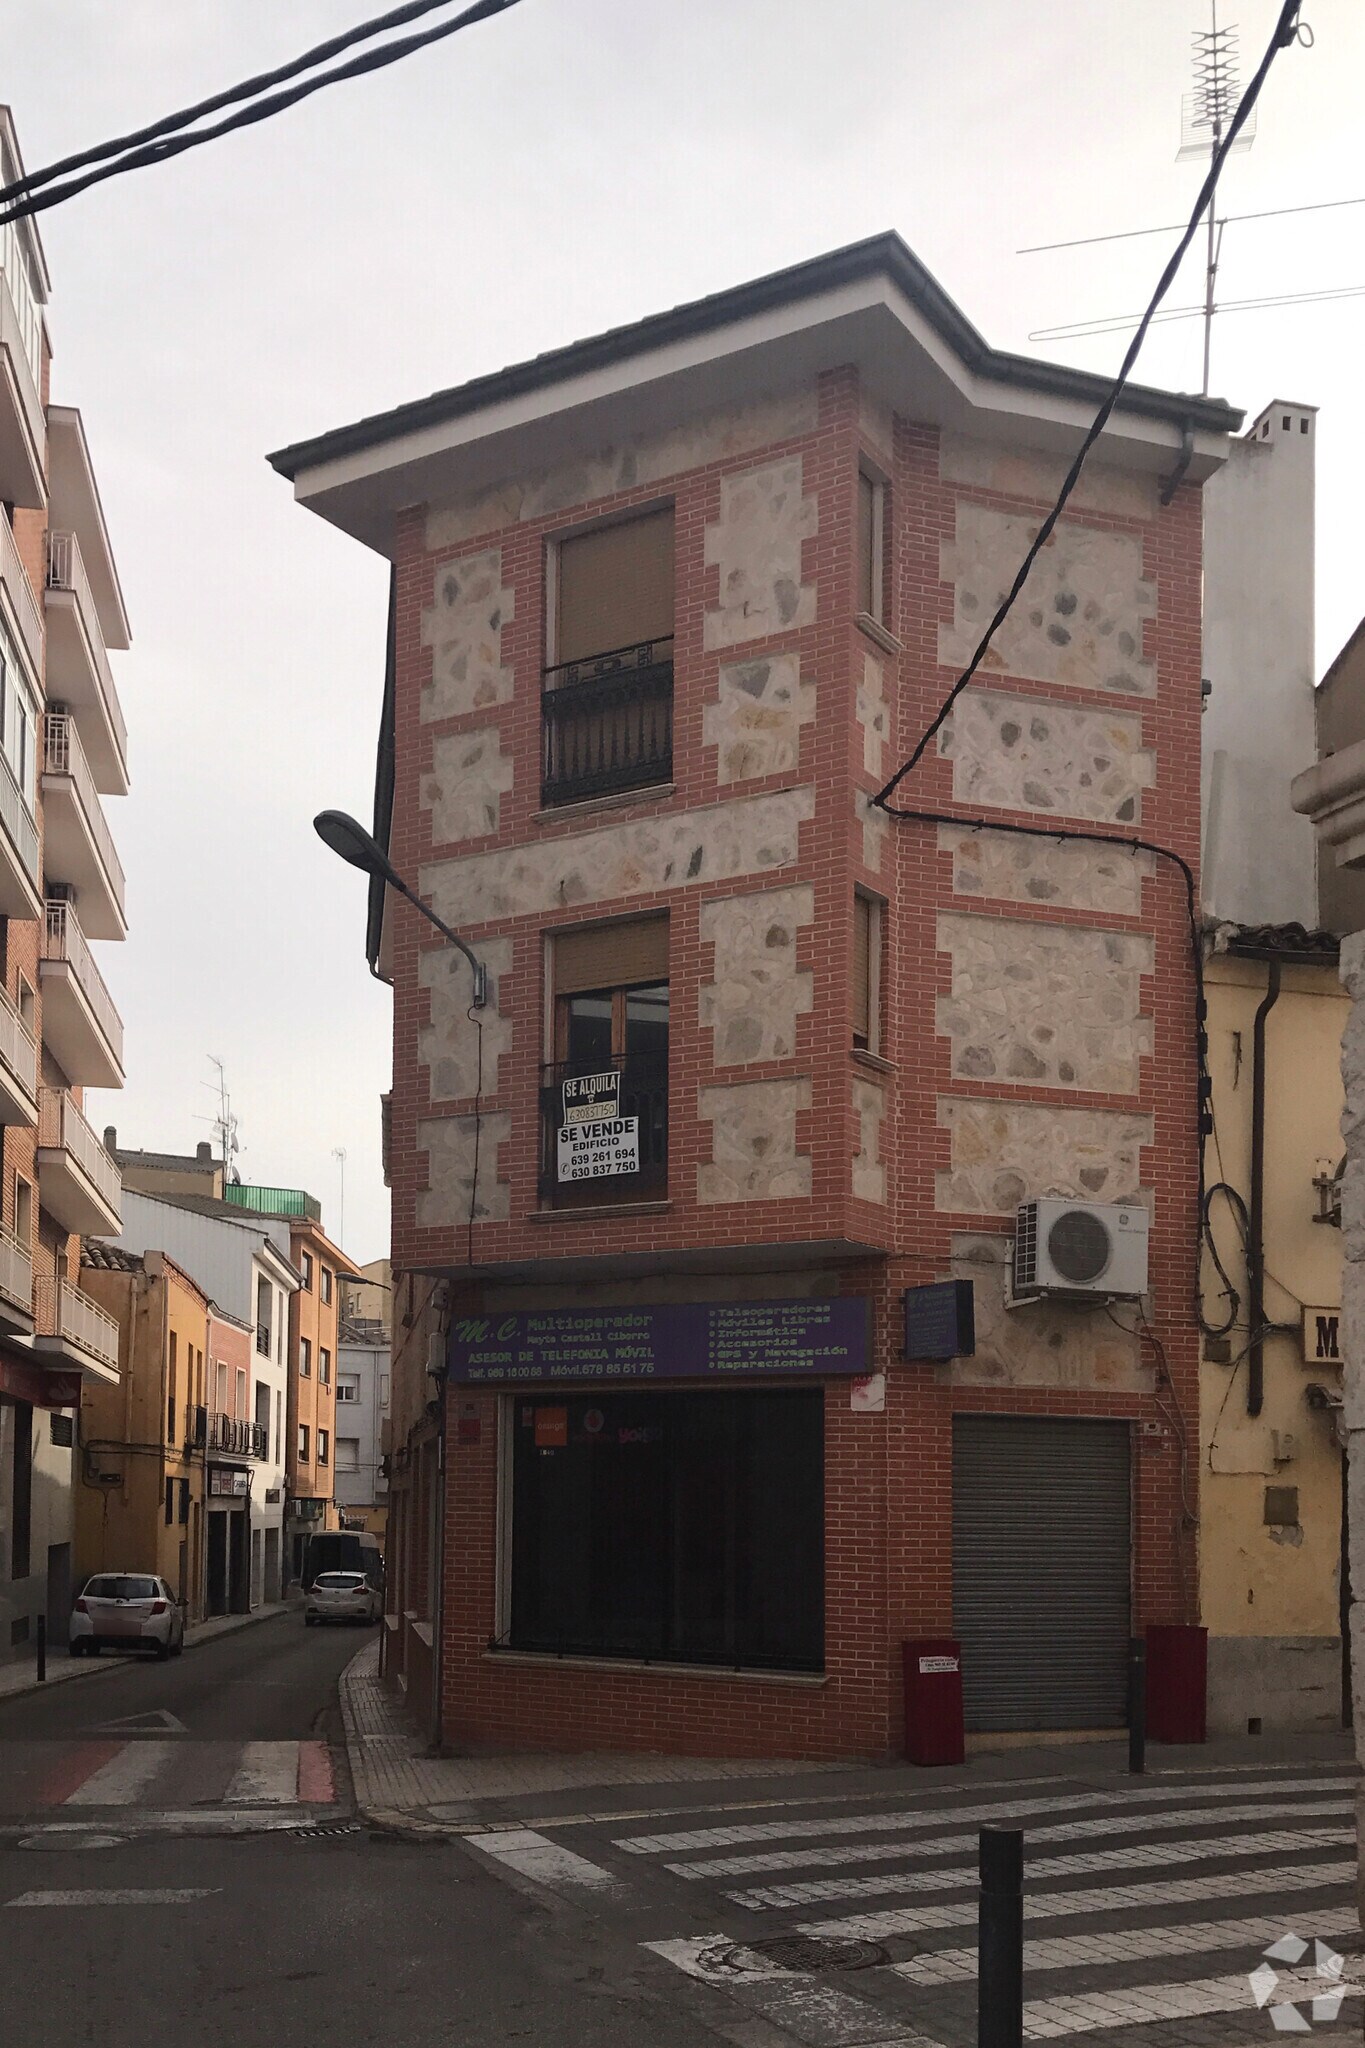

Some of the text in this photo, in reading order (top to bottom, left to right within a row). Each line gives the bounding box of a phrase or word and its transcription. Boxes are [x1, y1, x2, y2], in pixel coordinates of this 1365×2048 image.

[566, 1074, 617, 1098] SE ALQUILA
[569, 1104, 615, 1121] 630837750
[560, 1119, 635, 1143] SE VENDE
[572, 1137, 620, 1152] EDIFICIO
[571, 1147, 636, 1166] 639 261 694
[571, 1160, 636, 1179] 630 837 750
[527, 1313, 654, 1331] Multioperador
[717, 1337, 798, 1348] Accesorios
[1316, 1316, 1339, 1358] M
[468, 1351, 513, 1364] ASESOR
[518, 1351, 534, 1361] DE
[615, 1345, 655, 1359] MÓVIL
[748, 1350, 759, 1360] y
[717, 1359, 814, 1370] Reparaciones
